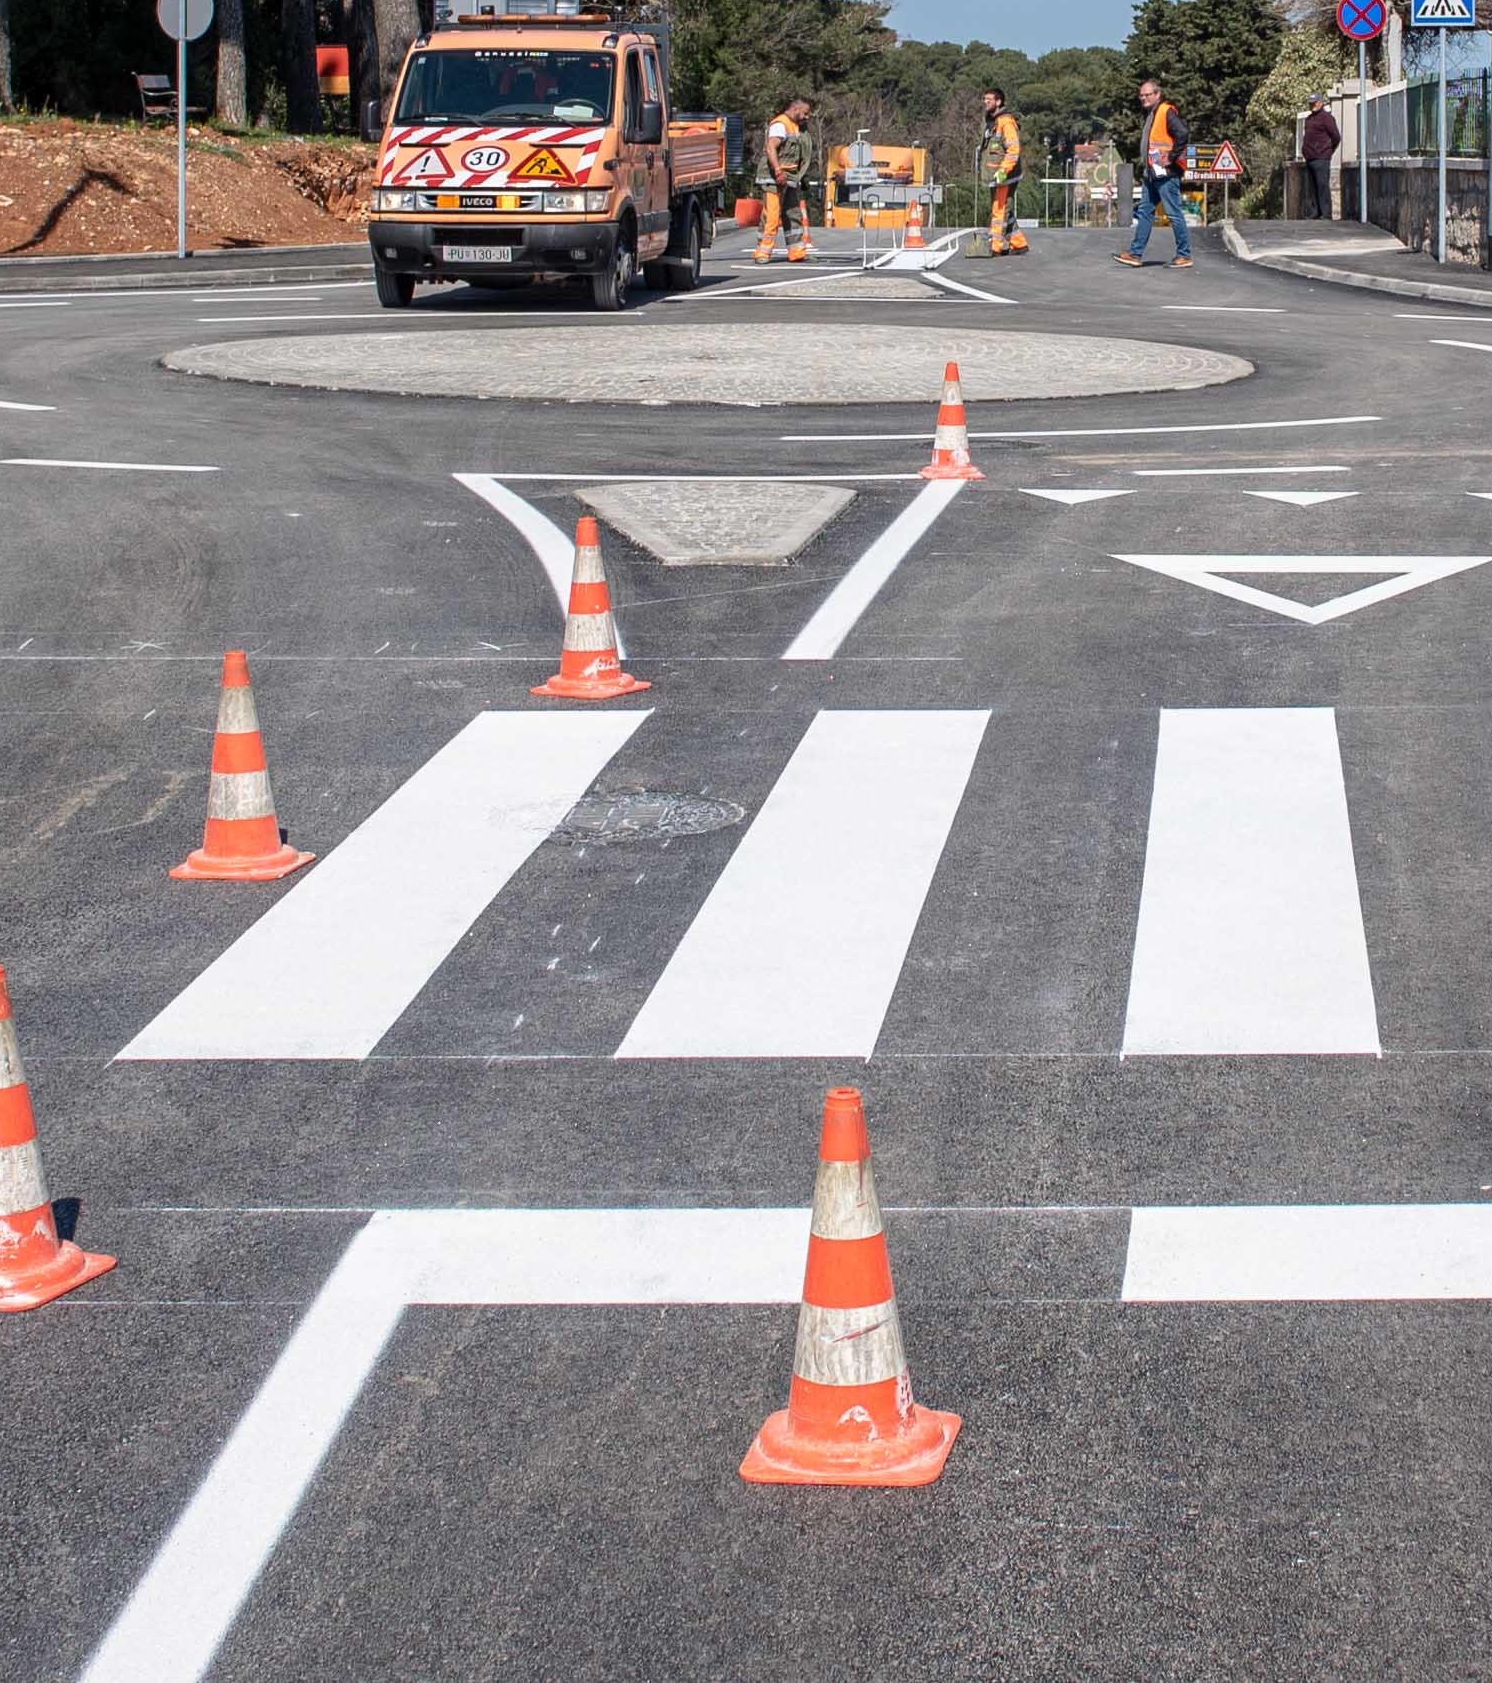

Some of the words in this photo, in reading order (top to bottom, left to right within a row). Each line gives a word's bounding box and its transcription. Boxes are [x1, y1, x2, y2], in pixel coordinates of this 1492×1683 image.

[469, 151, 501, 166] 30
[462, 197, 494, 206] IVECO
[450, 248, 464, 260] PU
